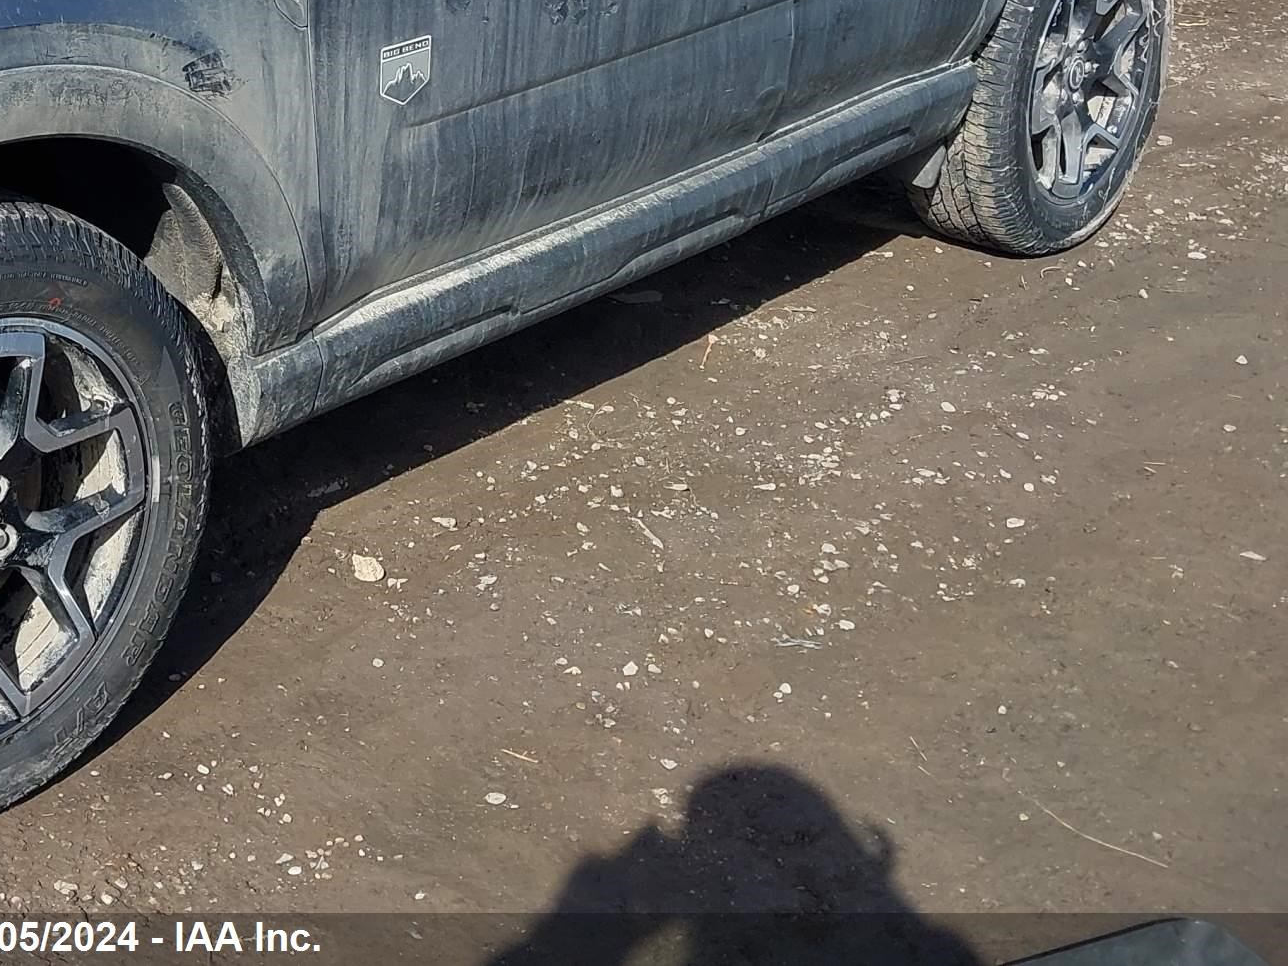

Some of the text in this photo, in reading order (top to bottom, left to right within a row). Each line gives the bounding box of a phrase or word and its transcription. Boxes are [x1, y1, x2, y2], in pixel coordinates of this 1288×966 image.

[383, 39, 429, 59] BIG BEND
[121, 401, 194, 666] GEOLANDAR
